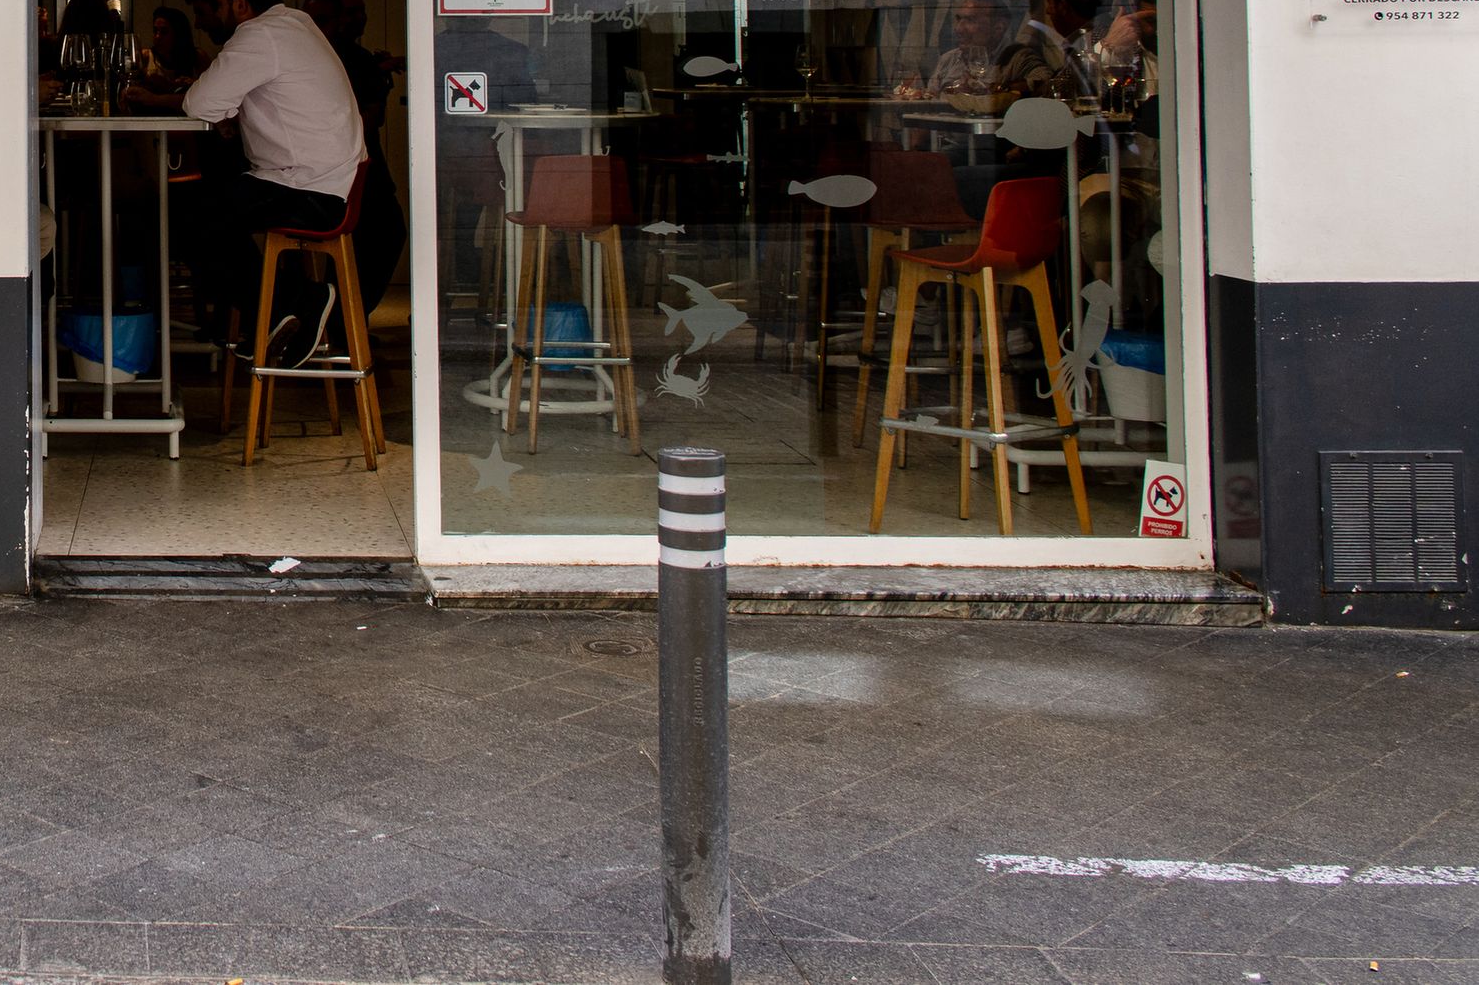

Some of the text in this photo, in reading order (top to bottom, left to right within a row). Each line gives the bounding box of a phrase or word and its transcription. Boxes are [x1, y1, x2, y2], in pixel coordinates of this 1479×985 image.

[1386, 11, 1460, 20] 954 871 322
